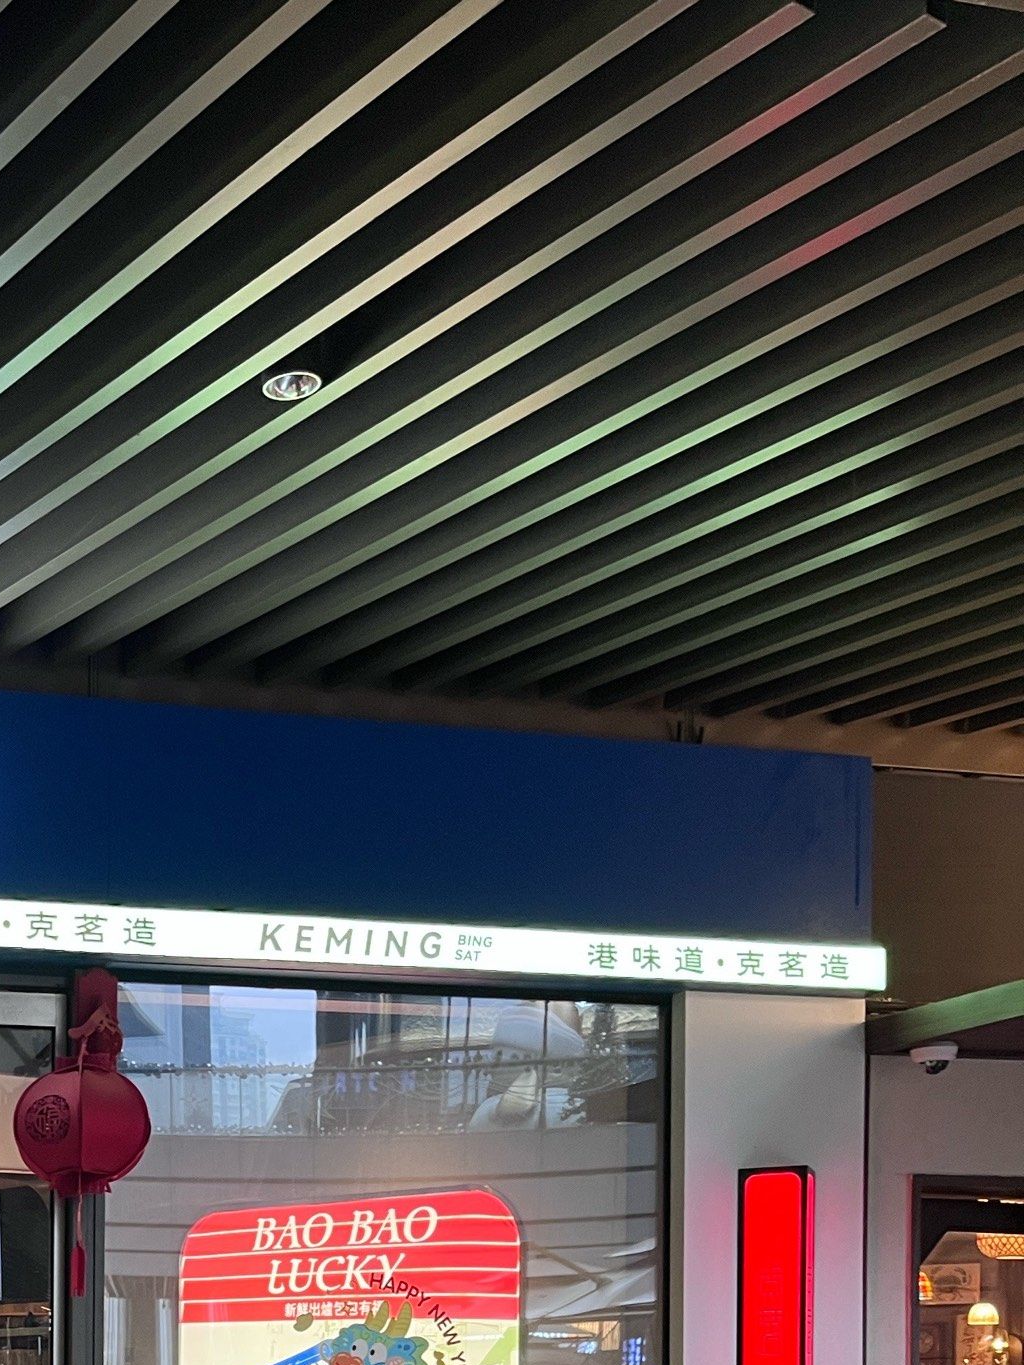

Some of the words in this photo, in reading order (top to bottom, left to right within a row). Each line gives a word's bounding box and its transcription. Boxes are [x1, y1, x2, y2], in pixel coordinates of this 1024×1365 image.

[259, 923, 443, 959] KEMING
[453, 949, 482, 963] SAT
[457, 934, 494, 949] BING
[252, 1212, 334, 1251] BAO
[347, 1206, 439, 1246] BAO
[267, 1253, 406, 1295] LUCKY
[369, 1272, 431, 1308] HAPPY
[427, 1304, 461, 1346] NEW
